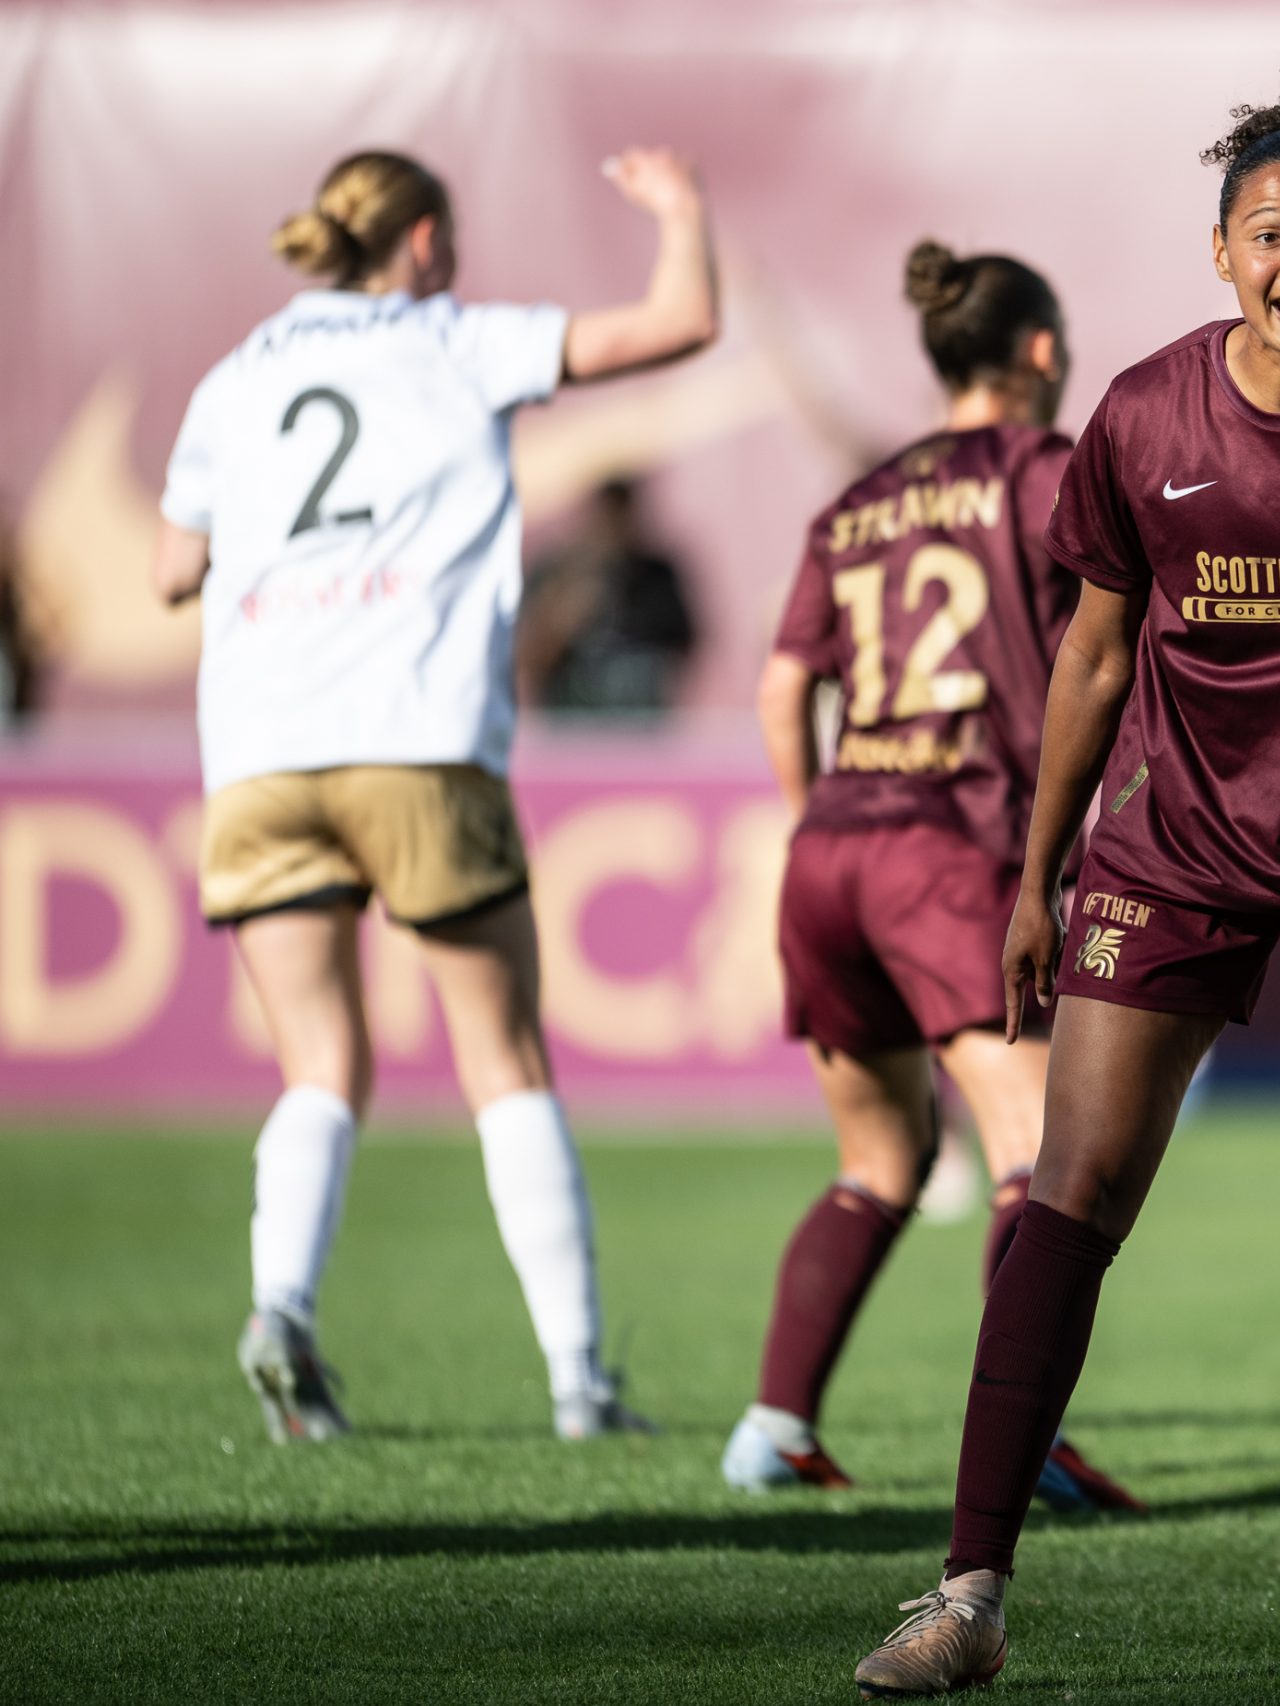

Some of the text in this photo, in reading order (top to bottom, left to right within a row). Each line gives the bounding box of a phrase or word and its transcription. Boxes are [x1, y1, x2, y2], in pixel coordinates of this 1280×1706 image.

[279, 386, 373, 541] 2
[833, 543, 990, 727] 12
[1226, 607, 1256, 616] FOR
